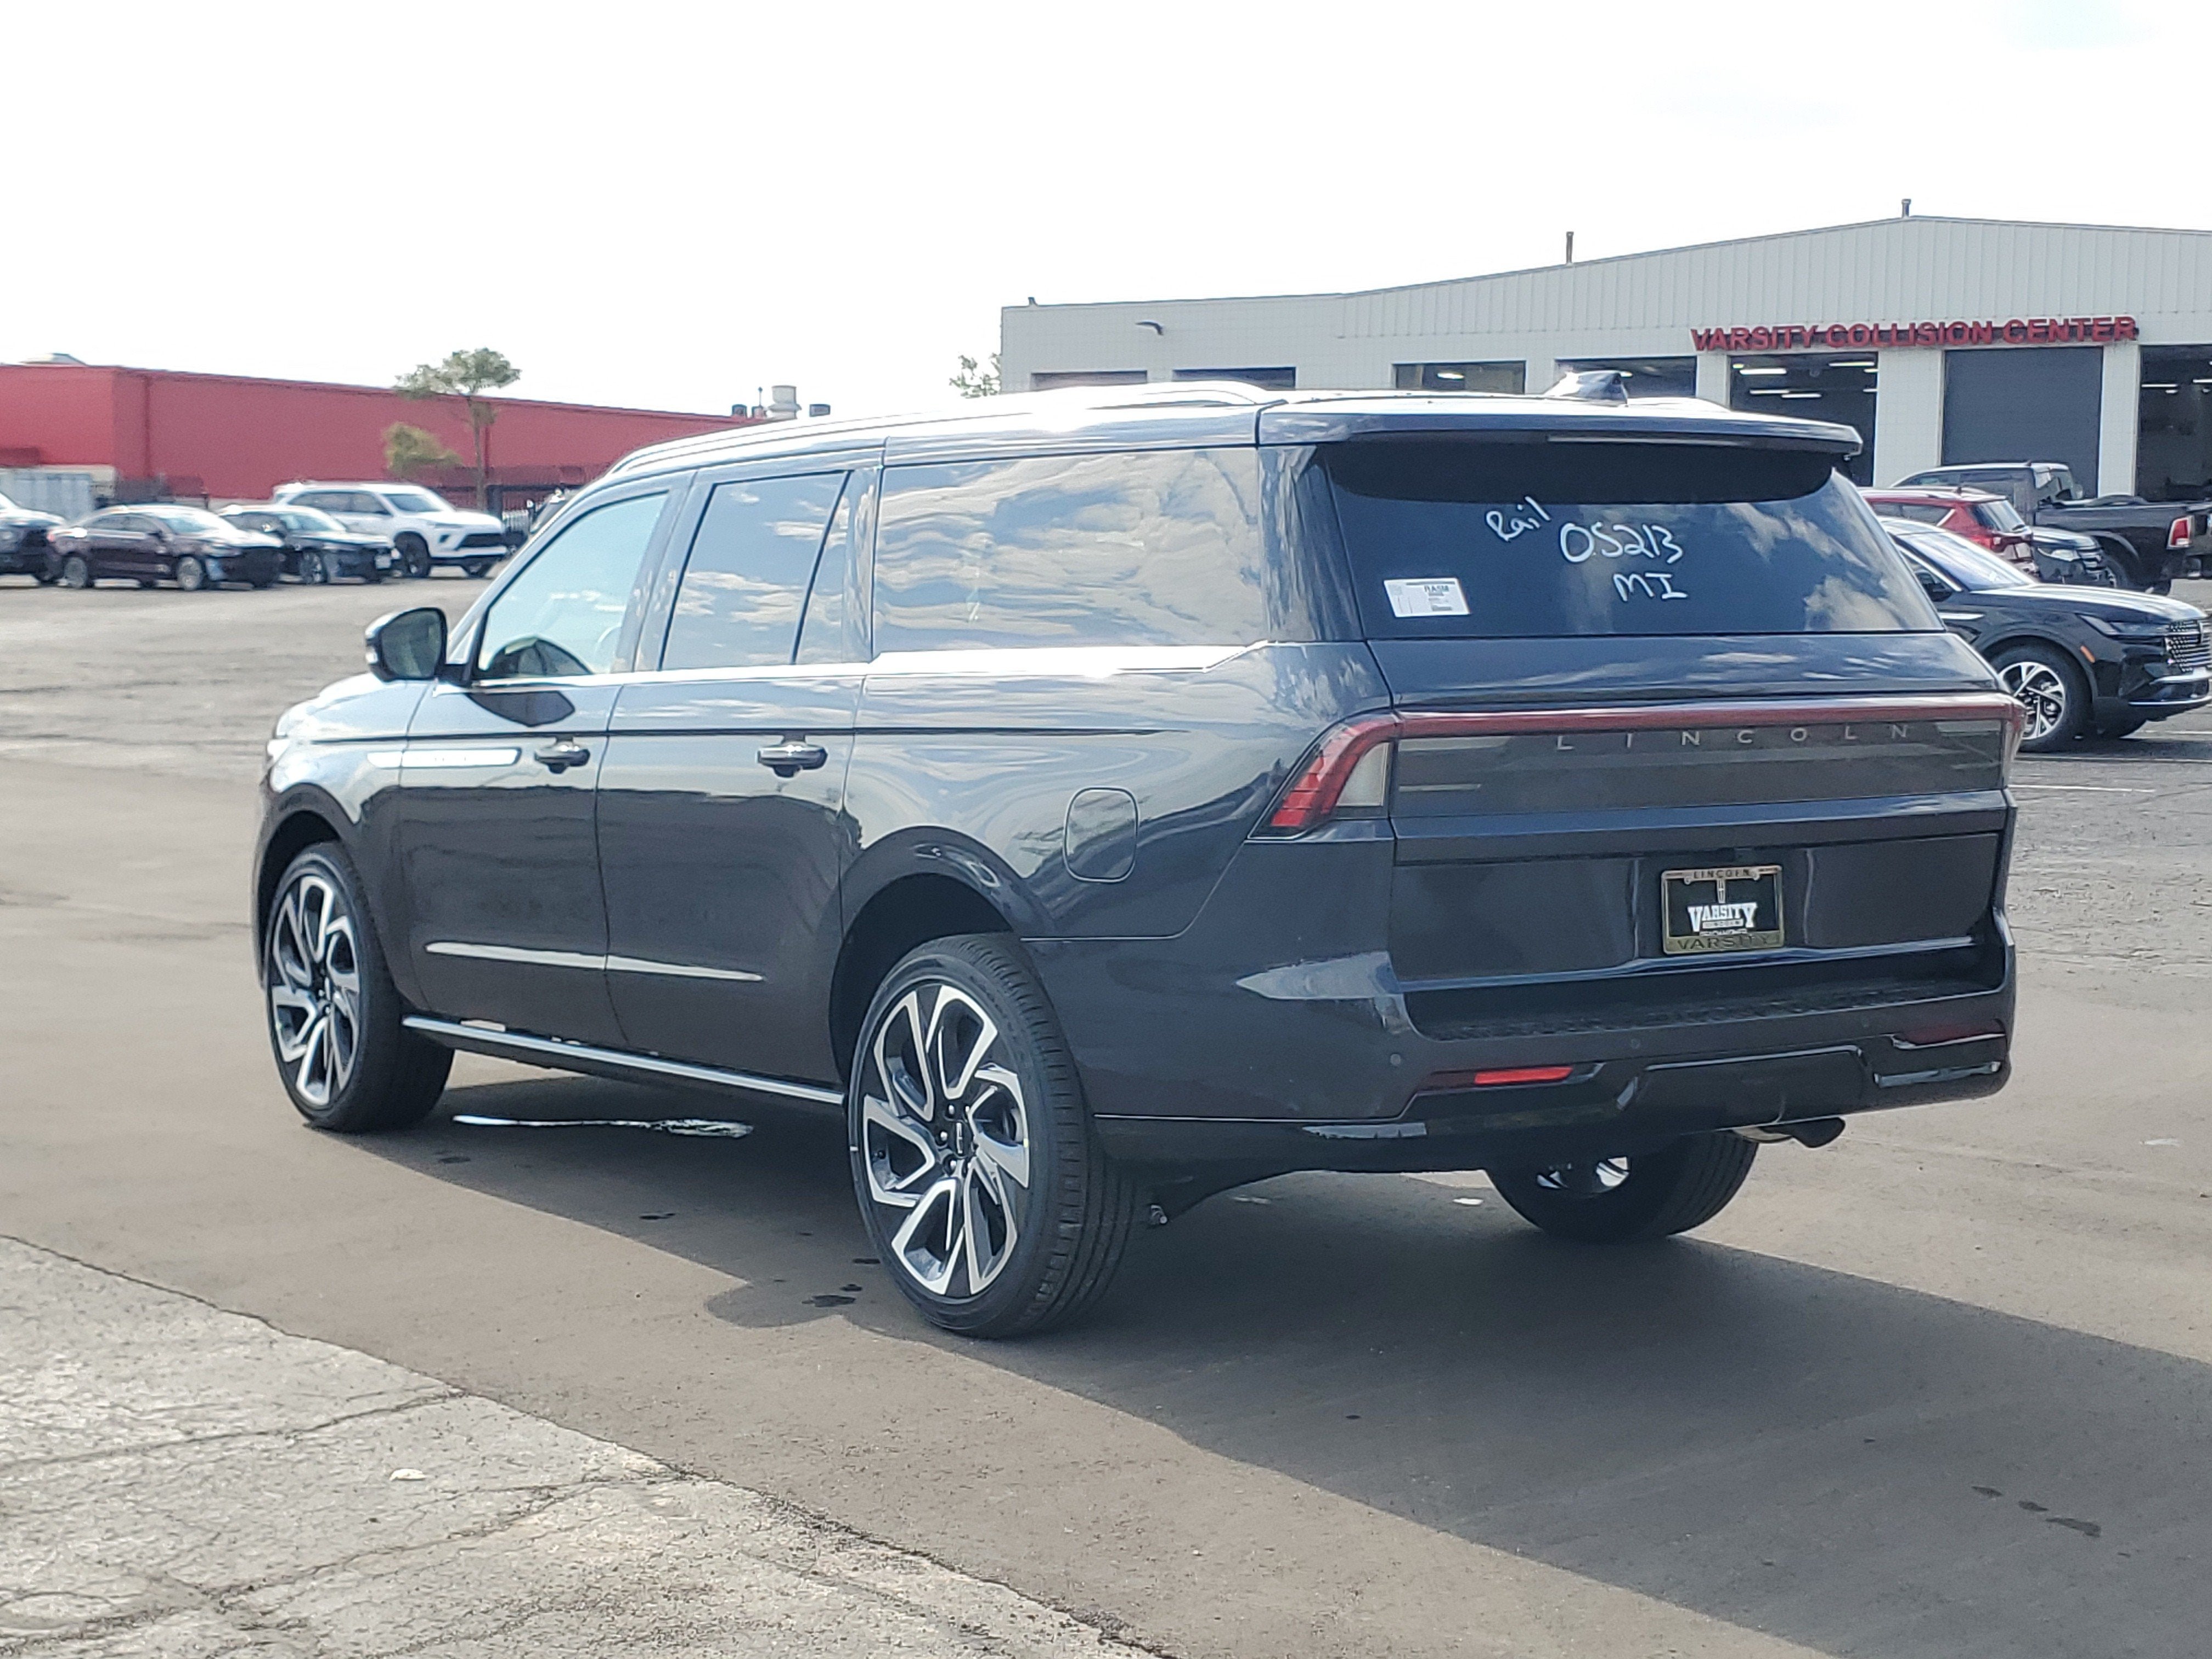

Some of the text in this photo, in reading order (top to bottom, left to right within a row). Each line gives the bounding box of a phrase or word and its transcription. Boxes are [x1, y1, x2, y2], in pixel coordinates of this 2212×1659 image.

[1691, 317, 2138, 351] VARSITY COLLISION CENTER
[1612, 572, 1688, 602] MI
[1556, 725, 1909, 751] LINCOLN
[1688, 902, 1757, 932] VARSITY
[1677, 934, 1770, 950] VARSITY
